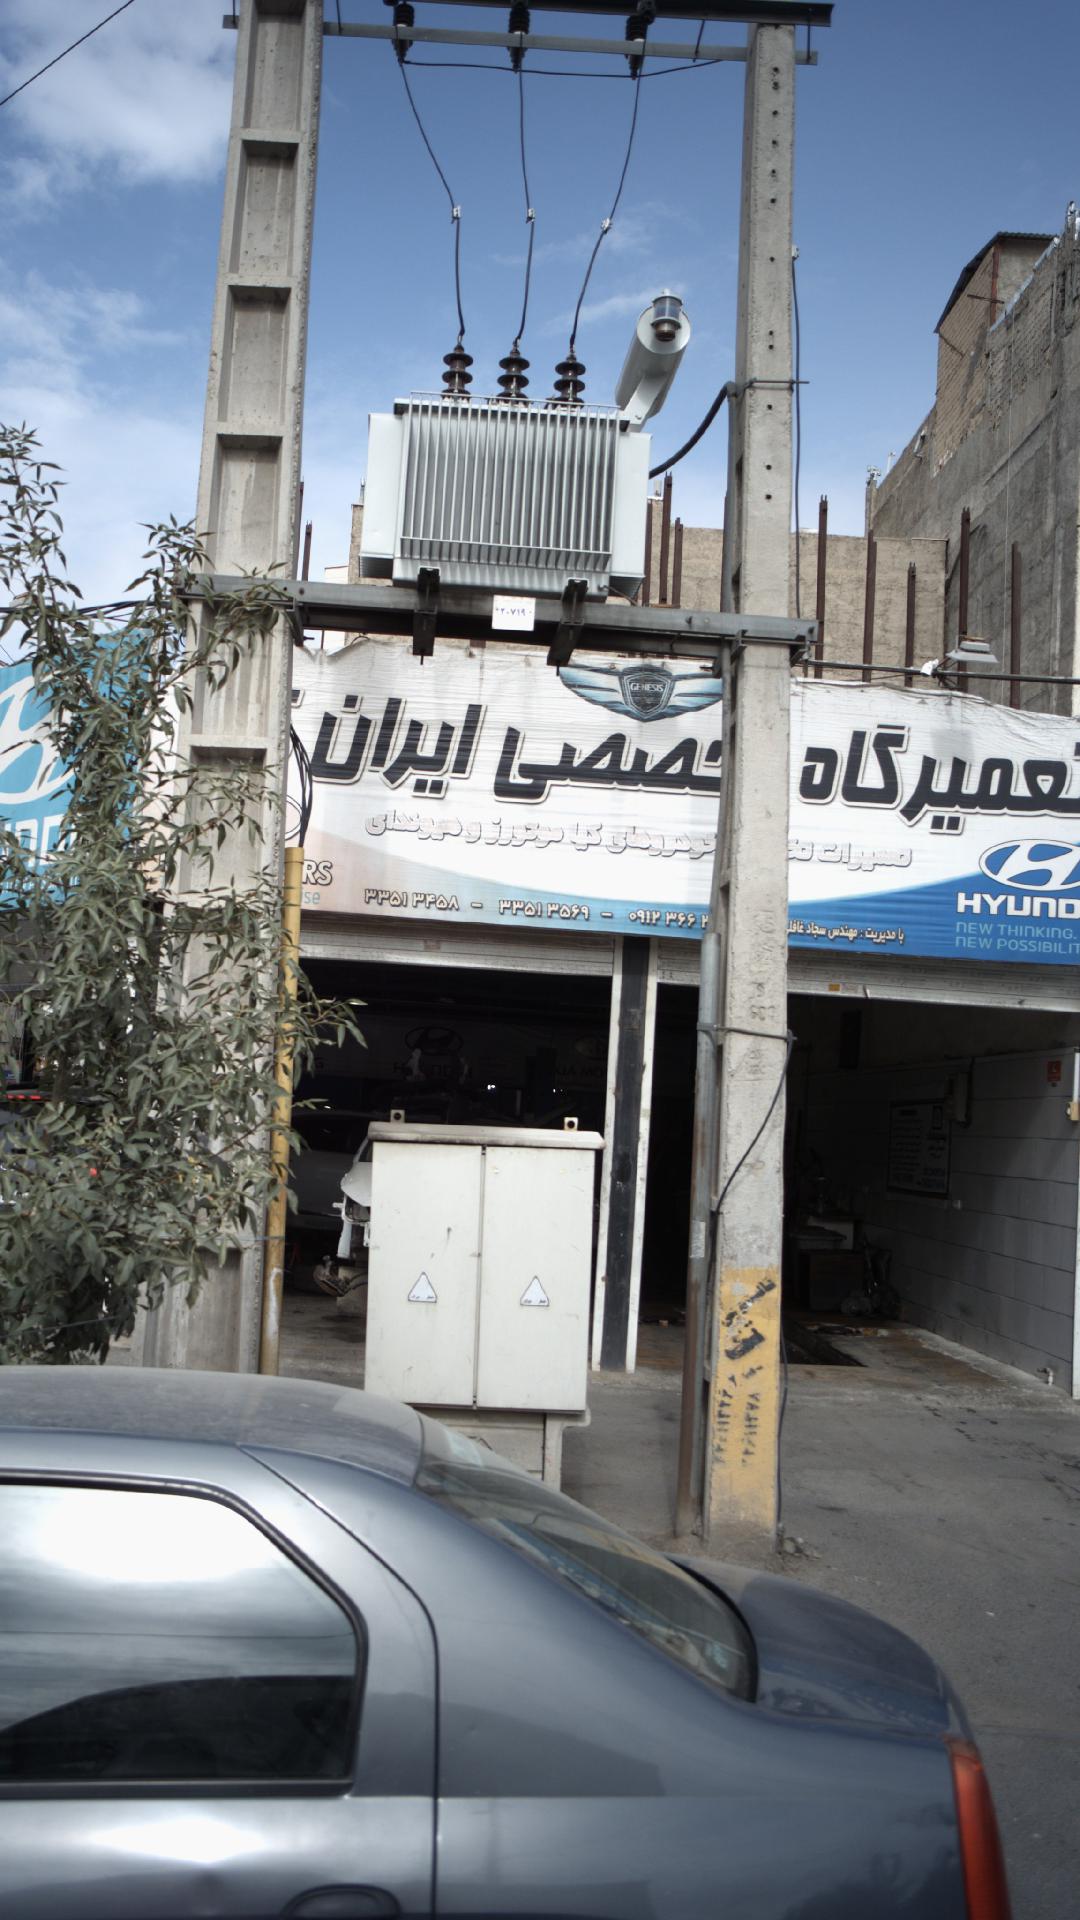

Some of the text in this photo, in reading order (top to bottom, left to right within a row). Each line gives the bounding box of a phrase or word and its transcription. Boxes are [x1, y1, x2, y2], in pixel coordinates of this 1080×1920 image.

[311, 694, 488, 799] ایران
[957, 892, 1080, 920] HYUND
[955, 921, 1078, 941] NEW THINKING.
[955, 936, 1080, 955] NEW POSSIBILIT
